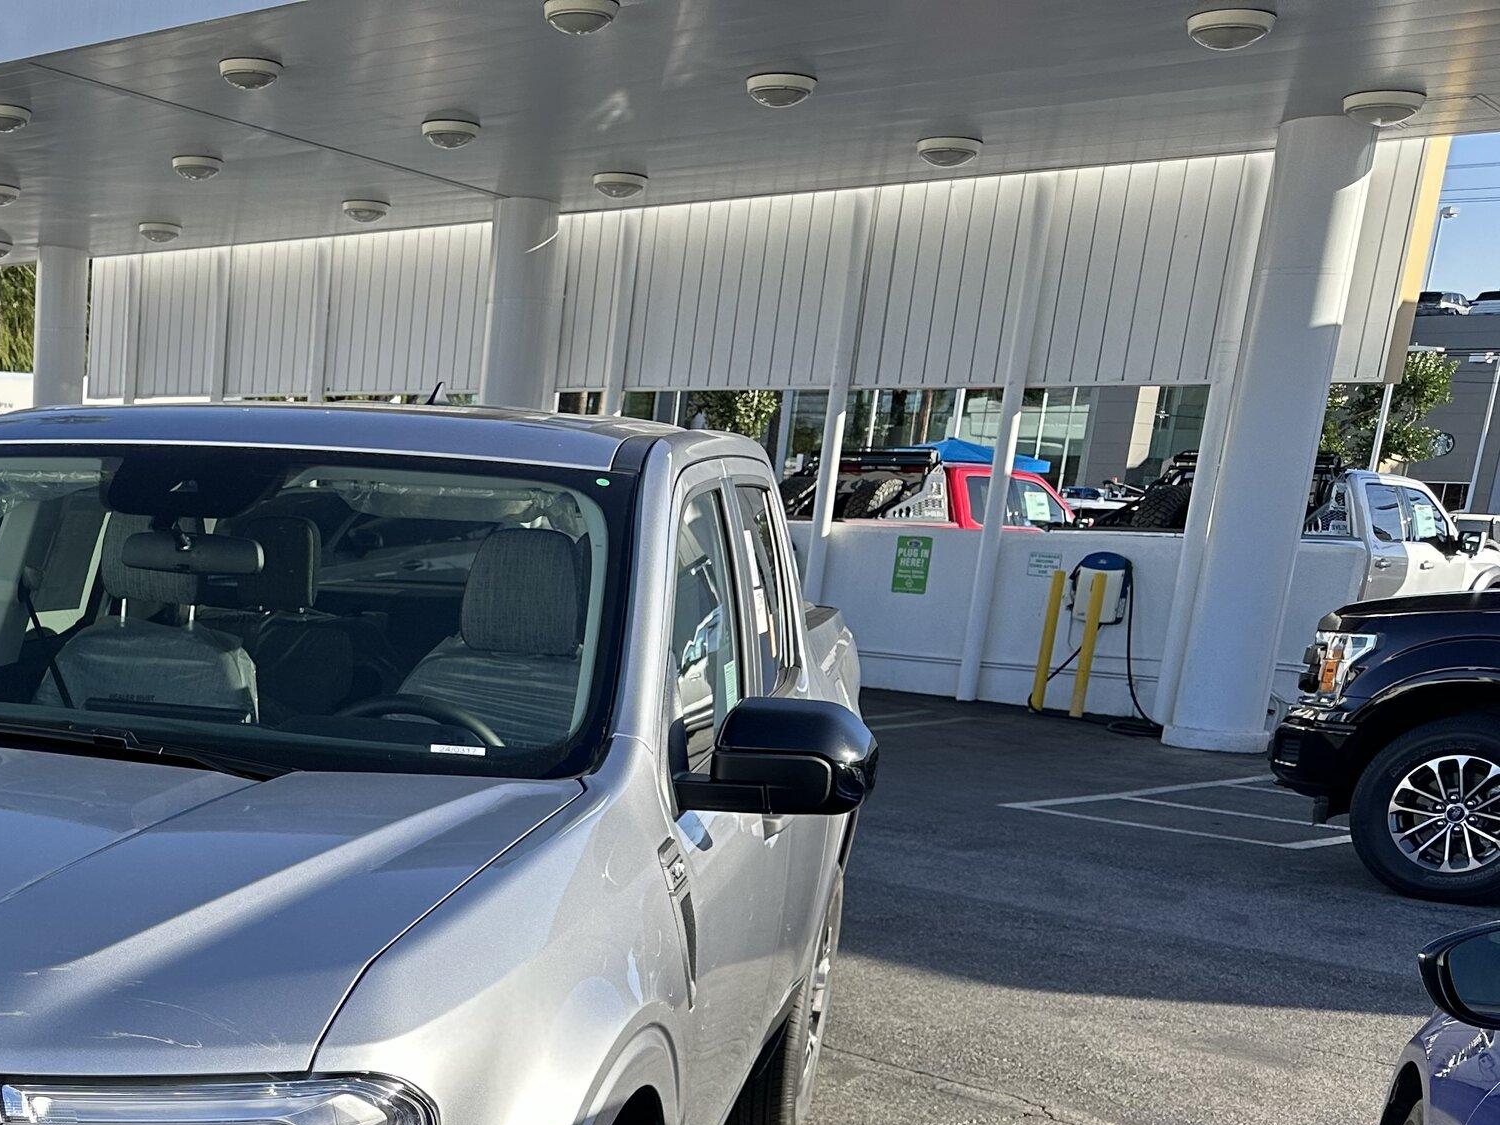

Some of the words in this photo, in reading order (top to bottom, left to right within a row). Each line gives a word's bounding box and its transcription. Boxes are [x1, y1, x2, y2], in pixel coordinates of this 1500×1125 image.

[897, 548, 919, 558] PLUG
[920, 549, 930, 558] IN
[900, 557, 924, 567] HERE!
